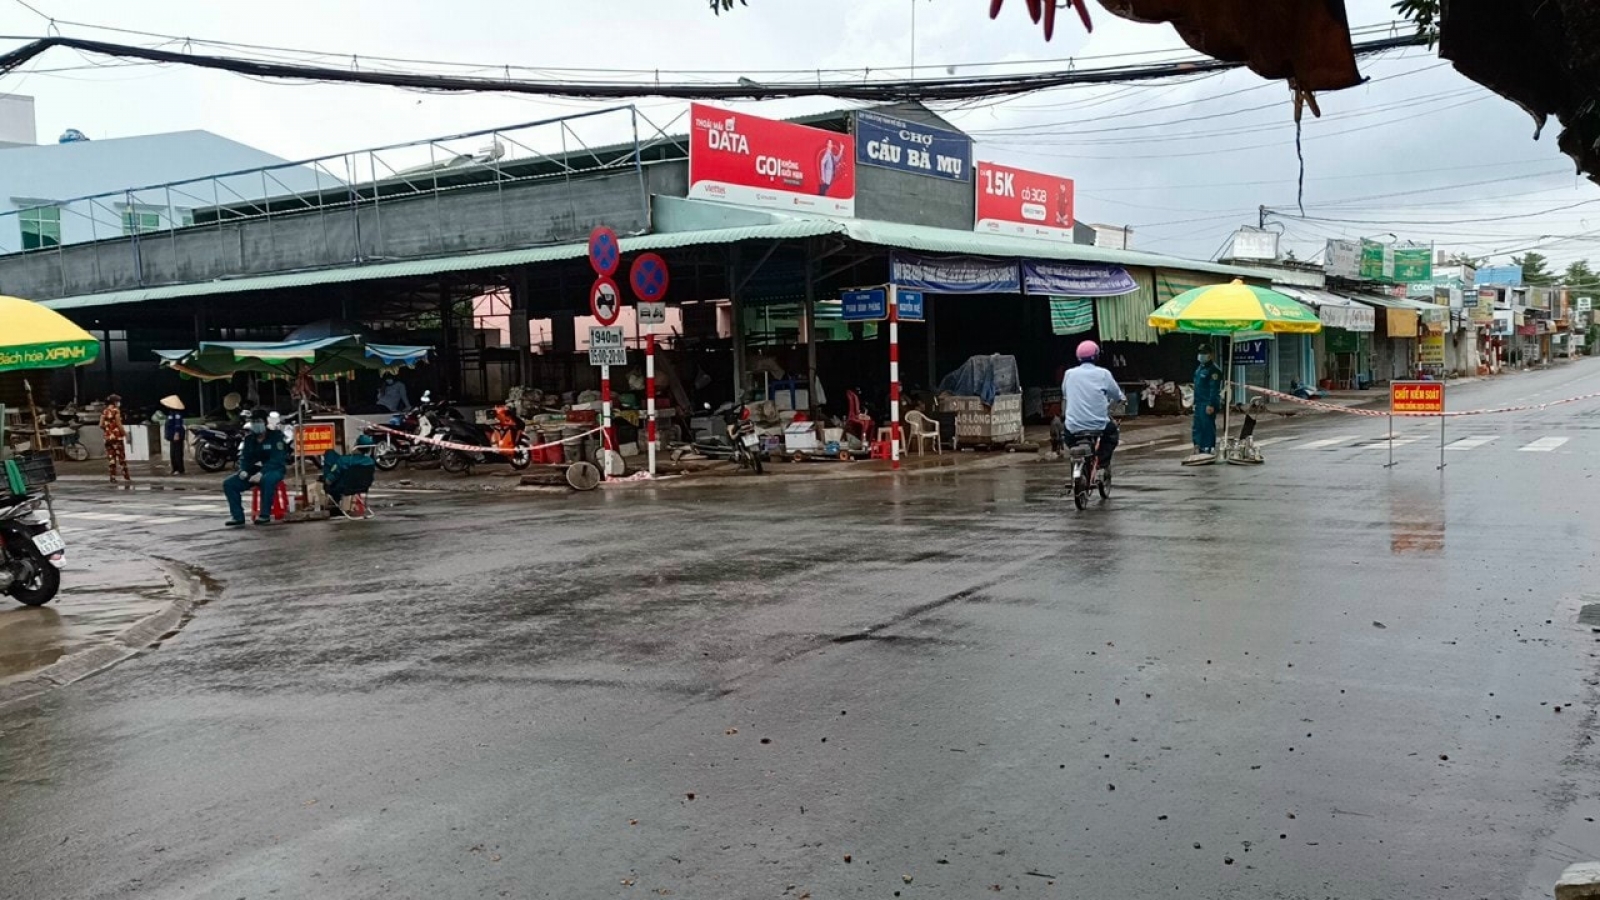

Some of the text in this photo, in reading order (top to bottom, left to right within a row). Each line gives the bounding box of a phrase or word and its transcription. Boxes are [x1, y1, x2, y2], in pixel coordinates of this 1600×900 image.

[708, 129, 750, 155] DATA
[898, 129, 933, 148] CHỢ
[866, 136, 962, 179] CẦU BÀ MỤ
[755, 155, 782, 181] GỌI
[985, 169, 1015, 198] 15K
[1031, 188, 1047, 203] 3GB
[594, 330, 618, 344] 940m
[45, 345, 86, 361] XANH
[1394, 385, 1410, 400] CHỐT
[1425, 386, 1440, 400] SOÁT
